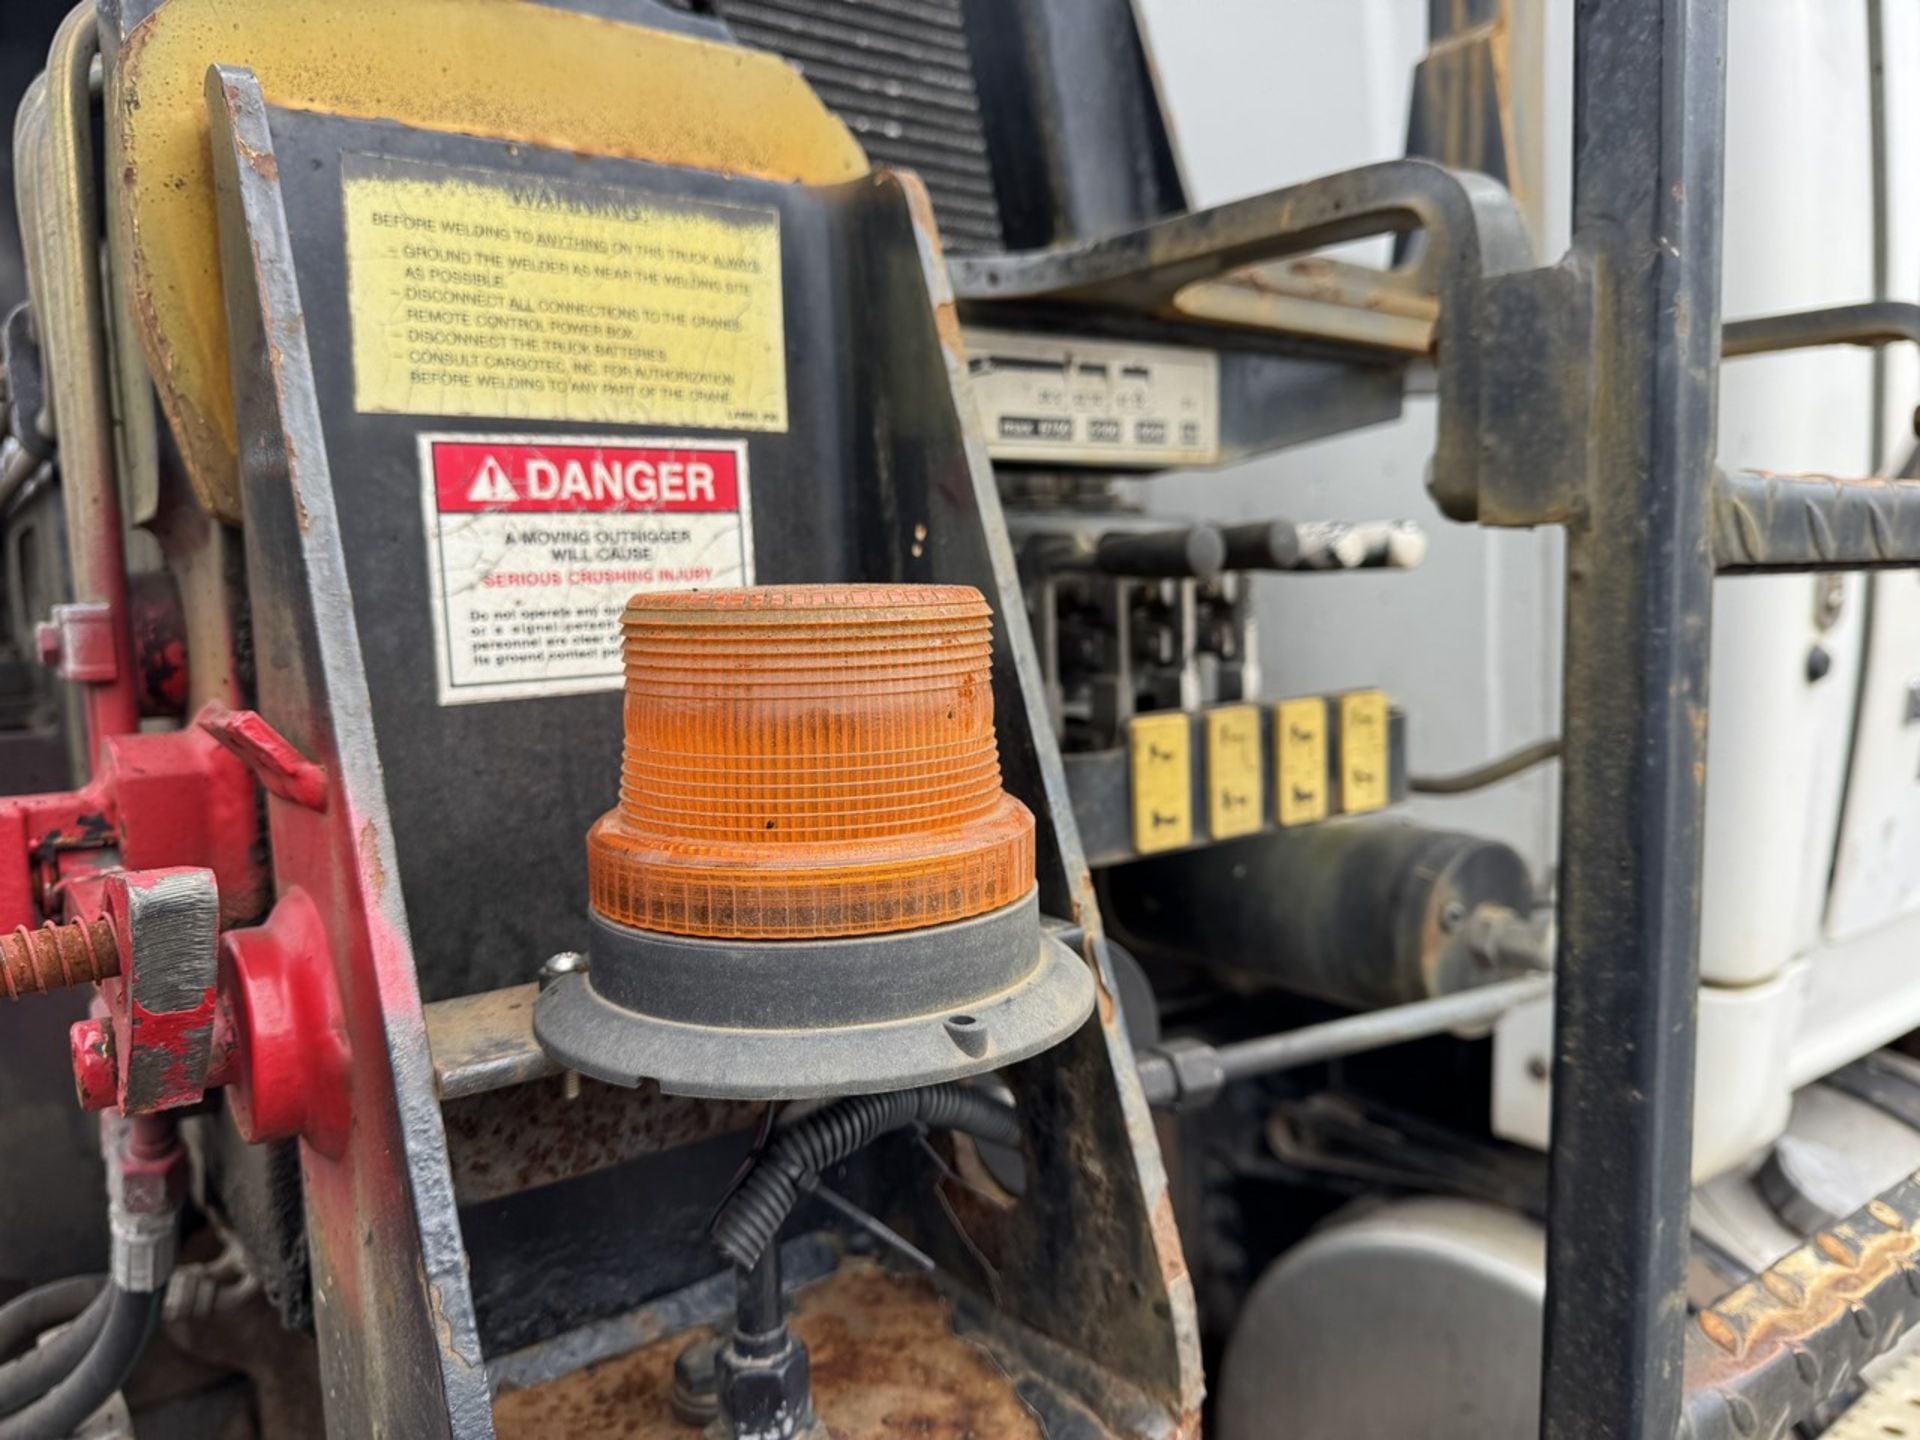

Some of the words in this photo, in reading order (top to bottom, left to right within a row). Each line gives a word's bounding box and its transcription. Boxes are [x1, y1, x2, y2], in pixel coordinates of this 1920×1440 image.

[372, 212, 436, 233] BEFORE
[441, 222, 511, 240] WELDING
[513, 230, 533, 243] TO
[537, 233, 607, 252] ANYTHING
[613, 242, 630, 253] ON
[402, 244, 472, 263] GROUND
[475, 252, 503, 266] THE
[508, 255, 569, 274] WELDER
[573, 263, 589, 275] AS
[594, 265, 632, 279] NEAR
[633, 271, 658, 284] THE
[664, 274, 722, 291] WELDING
[405, 266, 424, 280] AS
[405, 287, 504, 306] DISCONNECT
[509, 297, 534, 313] ALL
[538, 298, 639, 321] CONNECTIONS
[643, 311, 661, 324] TO
[663, 312, 688, 326] THE
[407, 309, 470, 324] REMOTE
[476, 313, 544, 330] CONTROL
[550, 321, 601, 335] POWER
[408, 329, 507, 348] DISCONNECT
[510, 336, 539, 350] THE
[543, 341, 590, 355] TRUCK
[409, 349, 478, 367] CONSULT
[603, 364, 631, 376] FOR
[635, 366, 735, 385] AUTHORIZATION
[410, 370, 471, 387] BEFORE
[476, 374, 545, 391] WELDING
[550, 379, 567, 392] TO
[571, 383, 599, 395] ANY
[603, 384, 636, 396] PART
[639, 386, 657, 398] OF
[660, 387, 684, 400] THE
[526, 458, 716, 502] DANGER
[505, 531, 517, 545] A
[522, 530, 590, 545] MOVING
[595, 529, 692, 544] OUTRIGGER
[551, 547, 591, 562] WILL
[596, 547, 651, 562] CAUSE
[483, 571, 562, 588] SERIOUS
[568, 568, 655, 585] CRUSHING
[658, 566, 713, 583] INJURY
[470, 610, 489, 621] Do
[494, 609, 515, 620] not
[521, 607, 571, 621] operate
[576, 606, 599, 618] any
[471, 628, 486, 637] or
[495, 627, 503, 635] a
[512, 622, 558, 635] signal
[564, 620, 616, 633] person
[472, 637, 542, 652] personnel
[546, 637, 567, 647] are
[572, 634, 603, 645] clear
[496, 652, 544, 667] ground
[549, 647, 598, 660] contact
